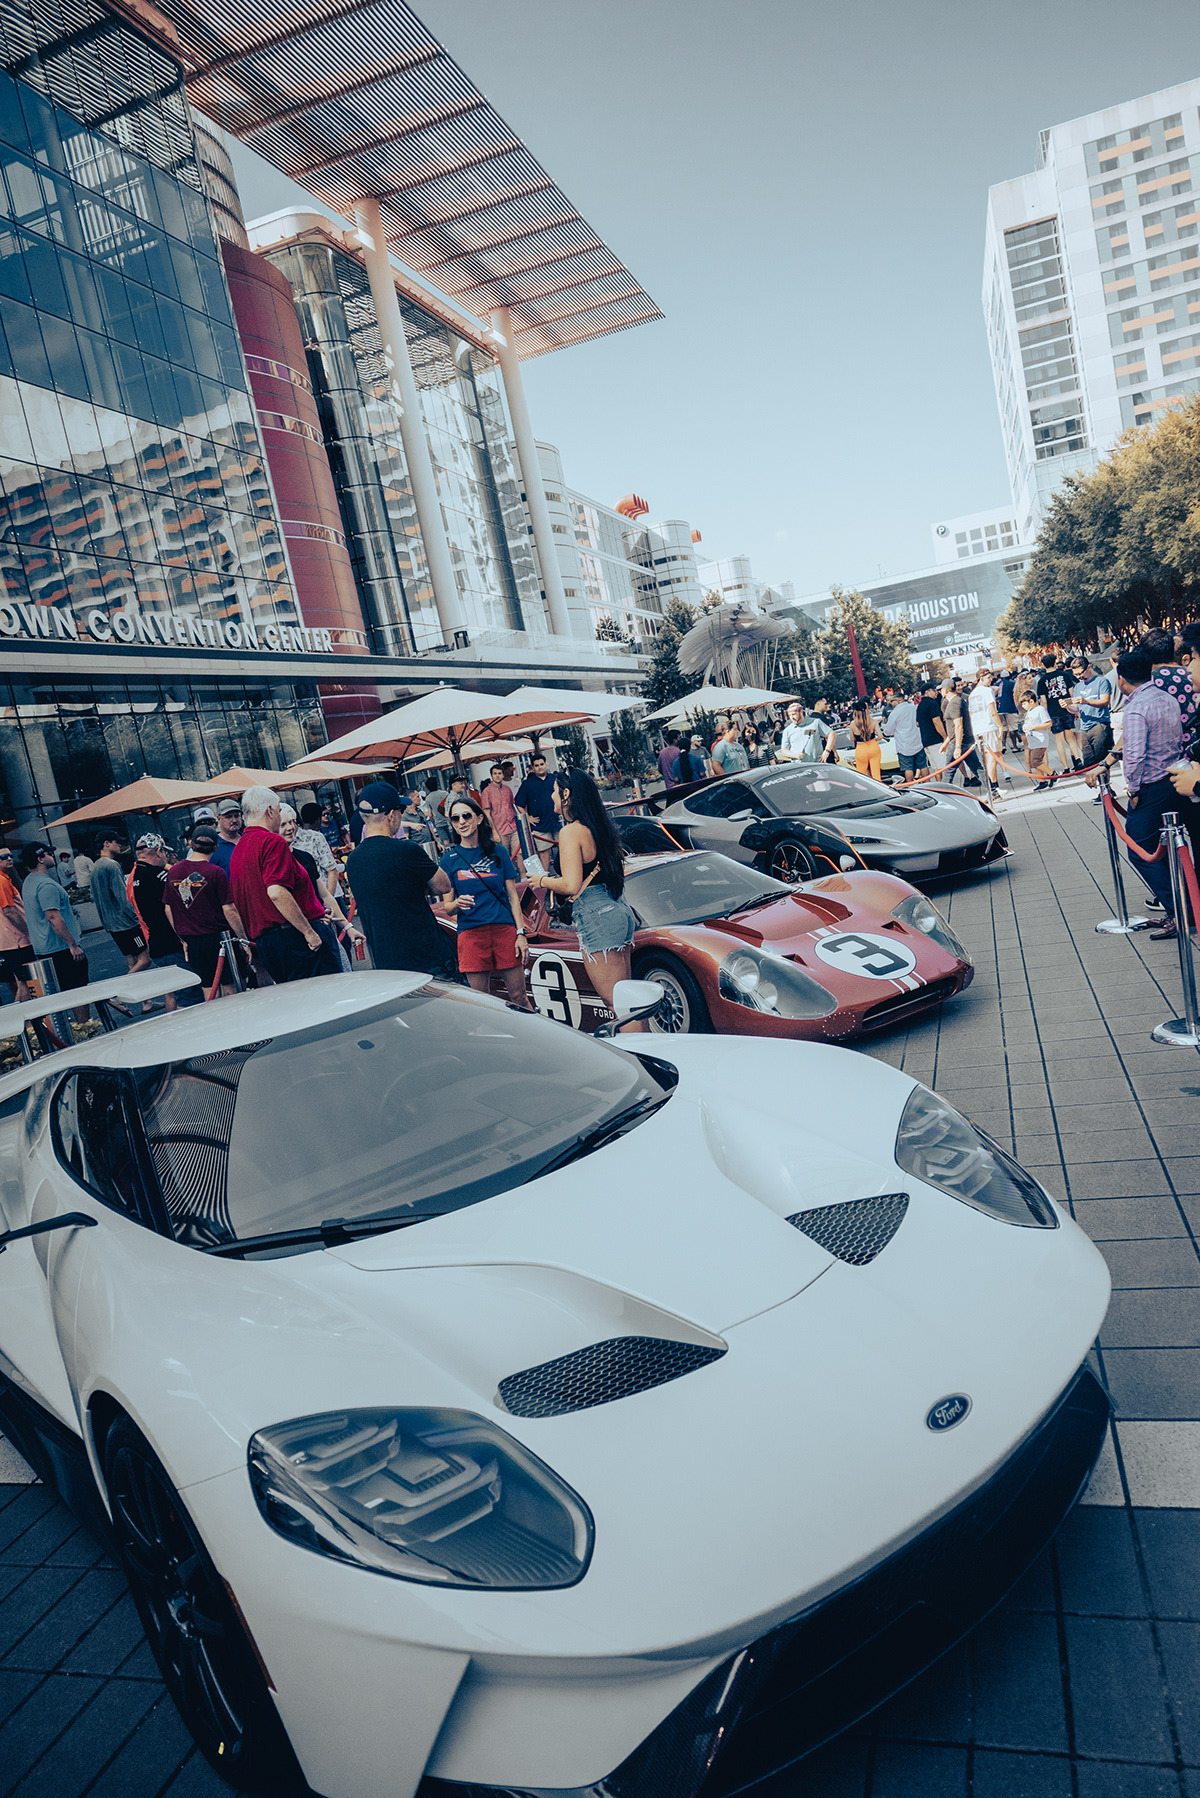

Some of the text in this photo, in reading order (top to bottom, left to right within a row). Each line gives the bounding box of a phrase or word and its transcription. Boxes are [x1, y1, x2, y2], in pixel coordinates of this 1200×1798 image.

[909, 592, 979, 624] HOUSTON
[0, 603, 334, 652] OWN CONVENTION CENTER
[920, 623, 955, 637] ENTERTAINMENT
[939, 641, 984, 657] PARKING
[821, 935, 909, 976] 3
[539, 961, 573, 1027] 3
[593, 1007, 615, 1020] FORD
